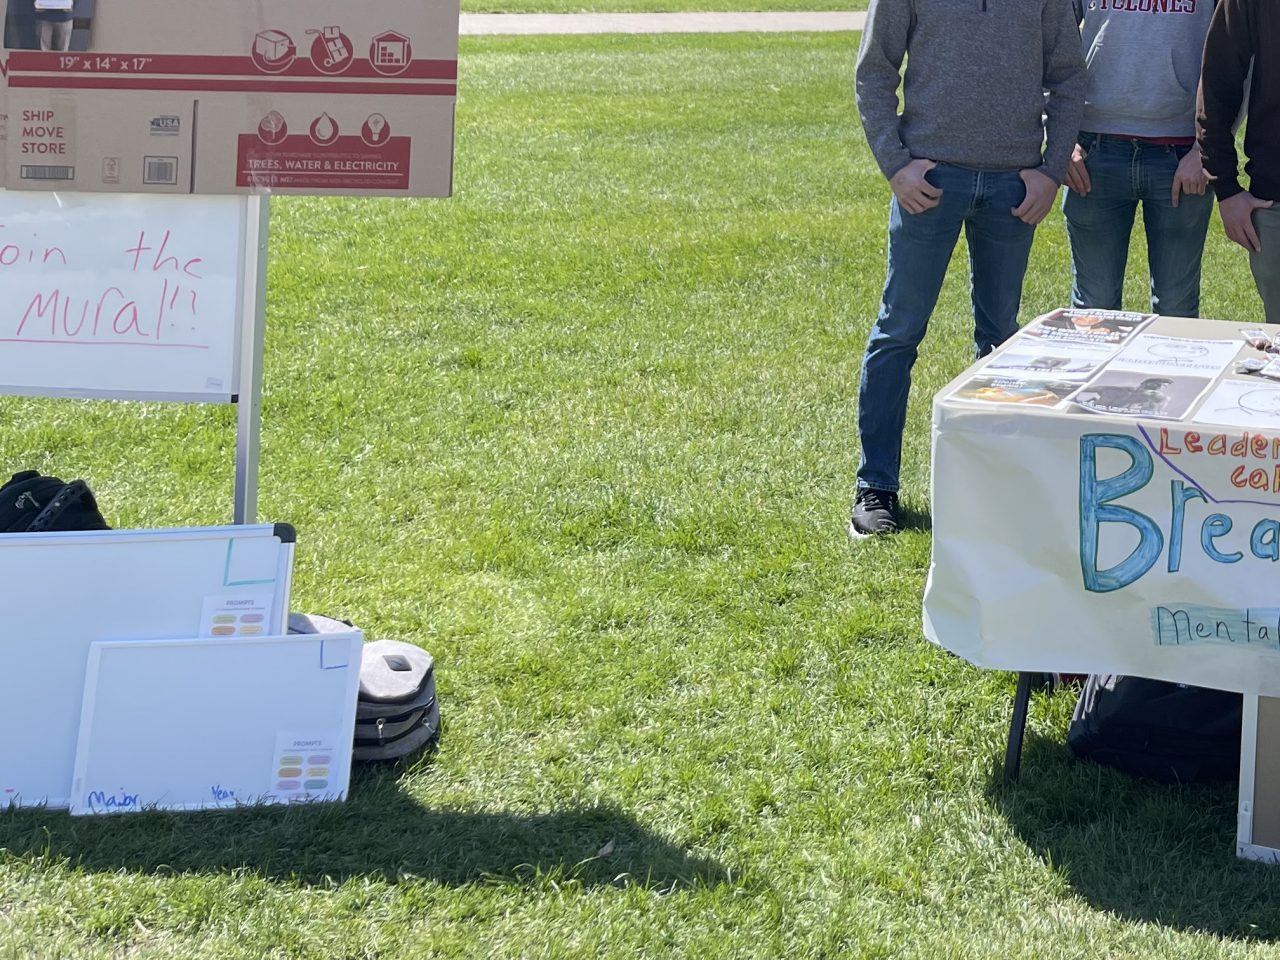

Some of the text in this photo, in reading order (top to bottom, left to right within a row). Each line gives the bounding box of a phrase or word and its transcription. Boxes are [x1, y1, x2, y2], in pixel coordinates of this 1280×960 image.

[60, 56, 152, 70] 19" x 14" x 17"
[22, 110, 54, 121] SHIP
[160, 119, 179, 128] USA
[22, 126, 64, 138] MOVE
[21, 142, 66, 154] STORE
[247, 159, 400, 171] TREES, WATER & ELECTRICITY
[0, 225, 203, 280] oin the
[88, 787, 140, 812] Major
